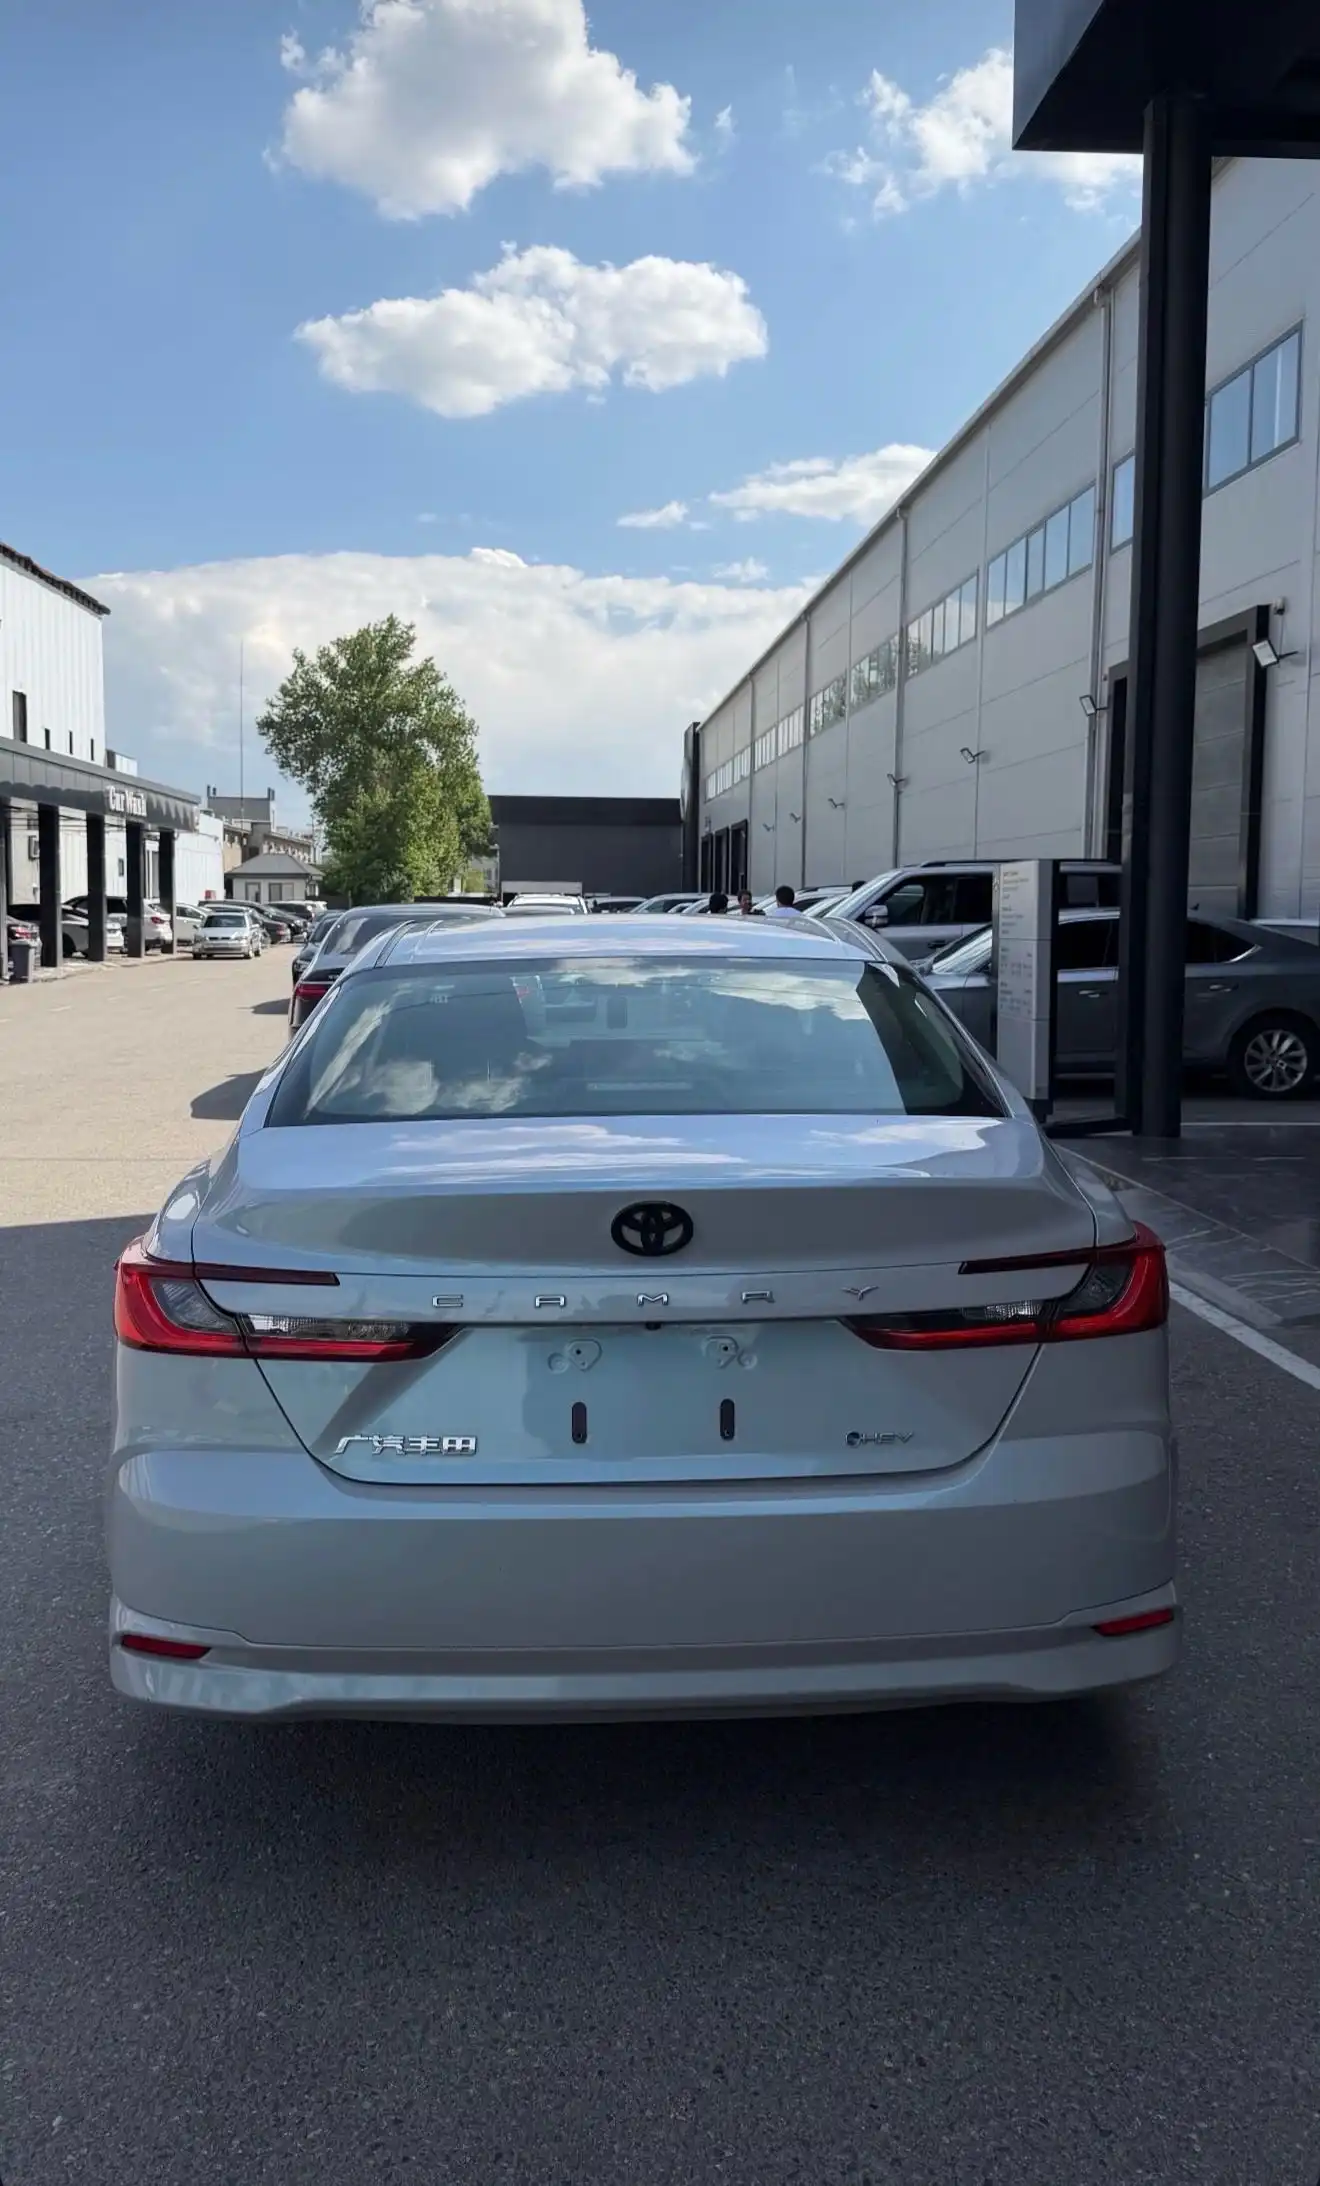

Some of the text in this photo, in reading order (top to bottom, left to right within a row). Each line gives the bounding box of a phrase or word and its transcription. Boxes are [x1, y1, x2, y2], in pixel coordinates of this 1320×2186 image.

[108, 786, 147, 816] Car Wash
[431, 1285, 879, 1309] CAMRY
[335, 1433, 477, 1456] 广汽丰田
